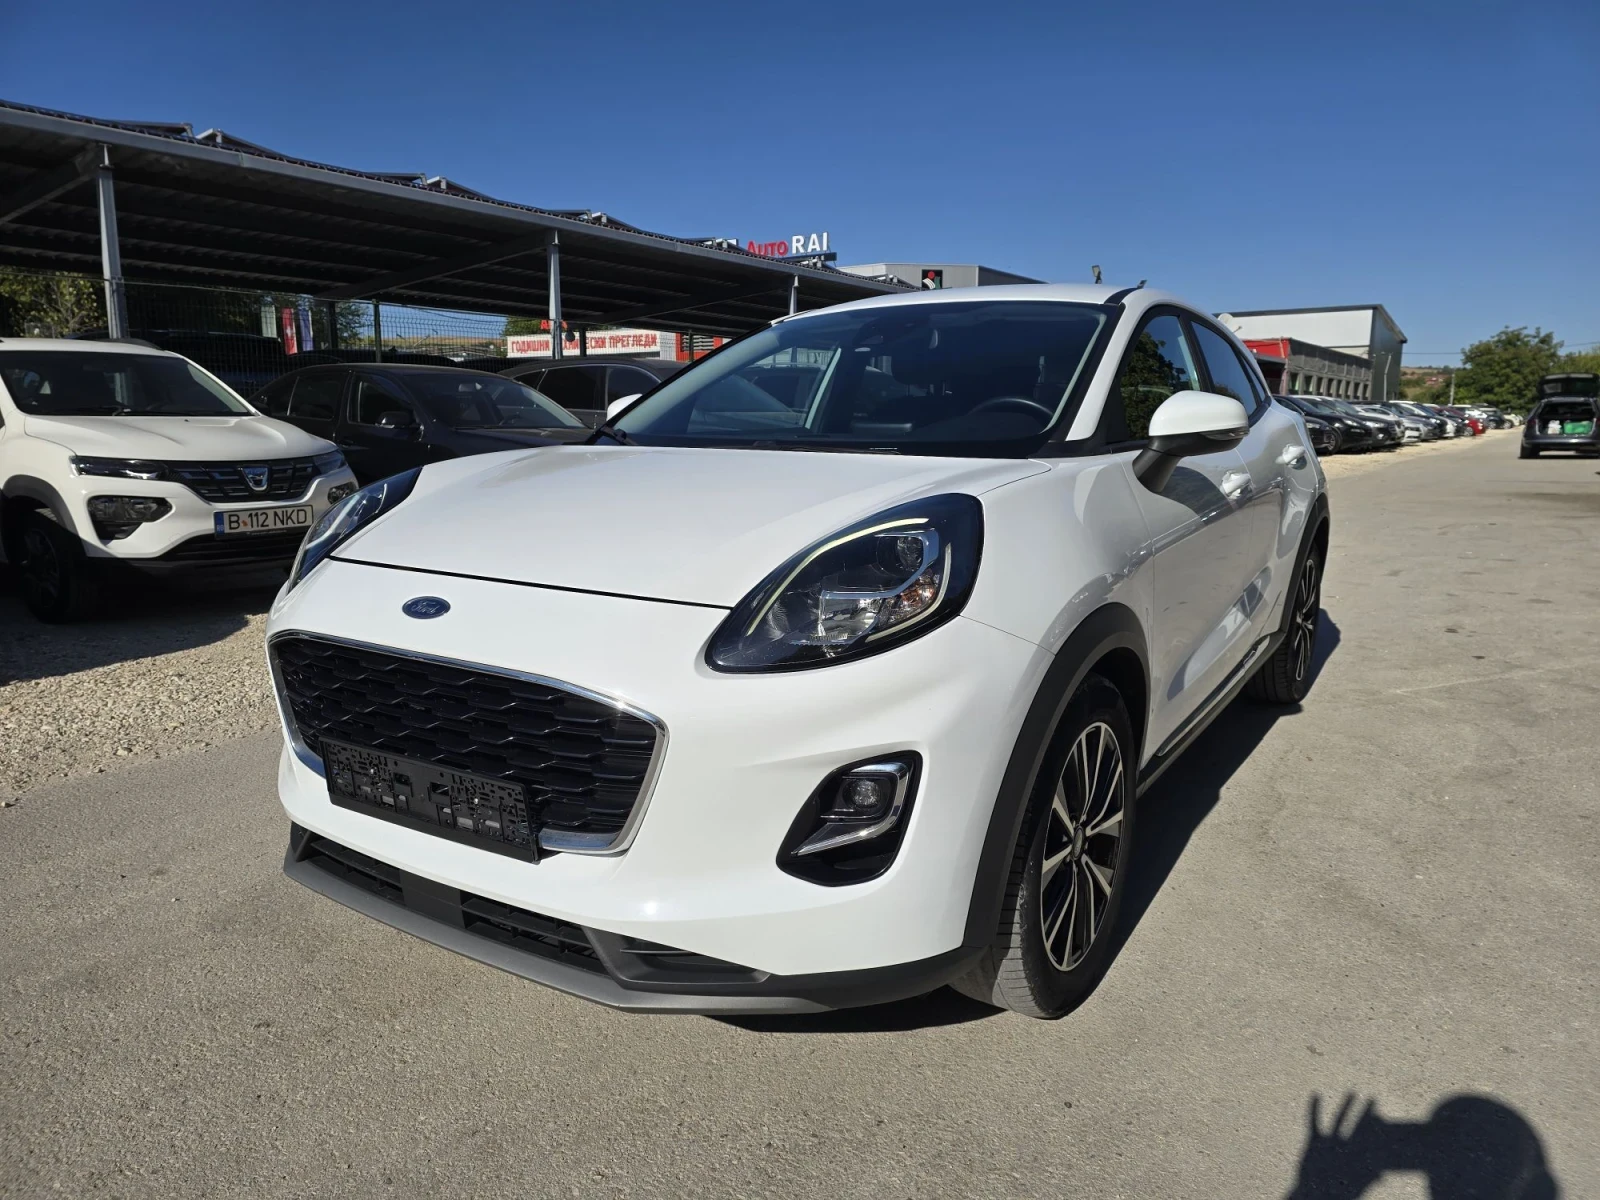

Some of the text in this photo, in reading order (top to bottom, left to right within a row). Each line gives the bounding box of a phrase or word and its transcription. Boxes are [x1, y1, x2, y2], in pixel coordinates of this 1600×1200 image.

[792, 232, 828, 254] RAI
[511, 339, 550, 354] ГОДИШНИ
[608, 333, 658, 349] ПРЕГЛЕДИ
[247, 511, 269, 528] 112
[273, 508, 308, 526] NKD
